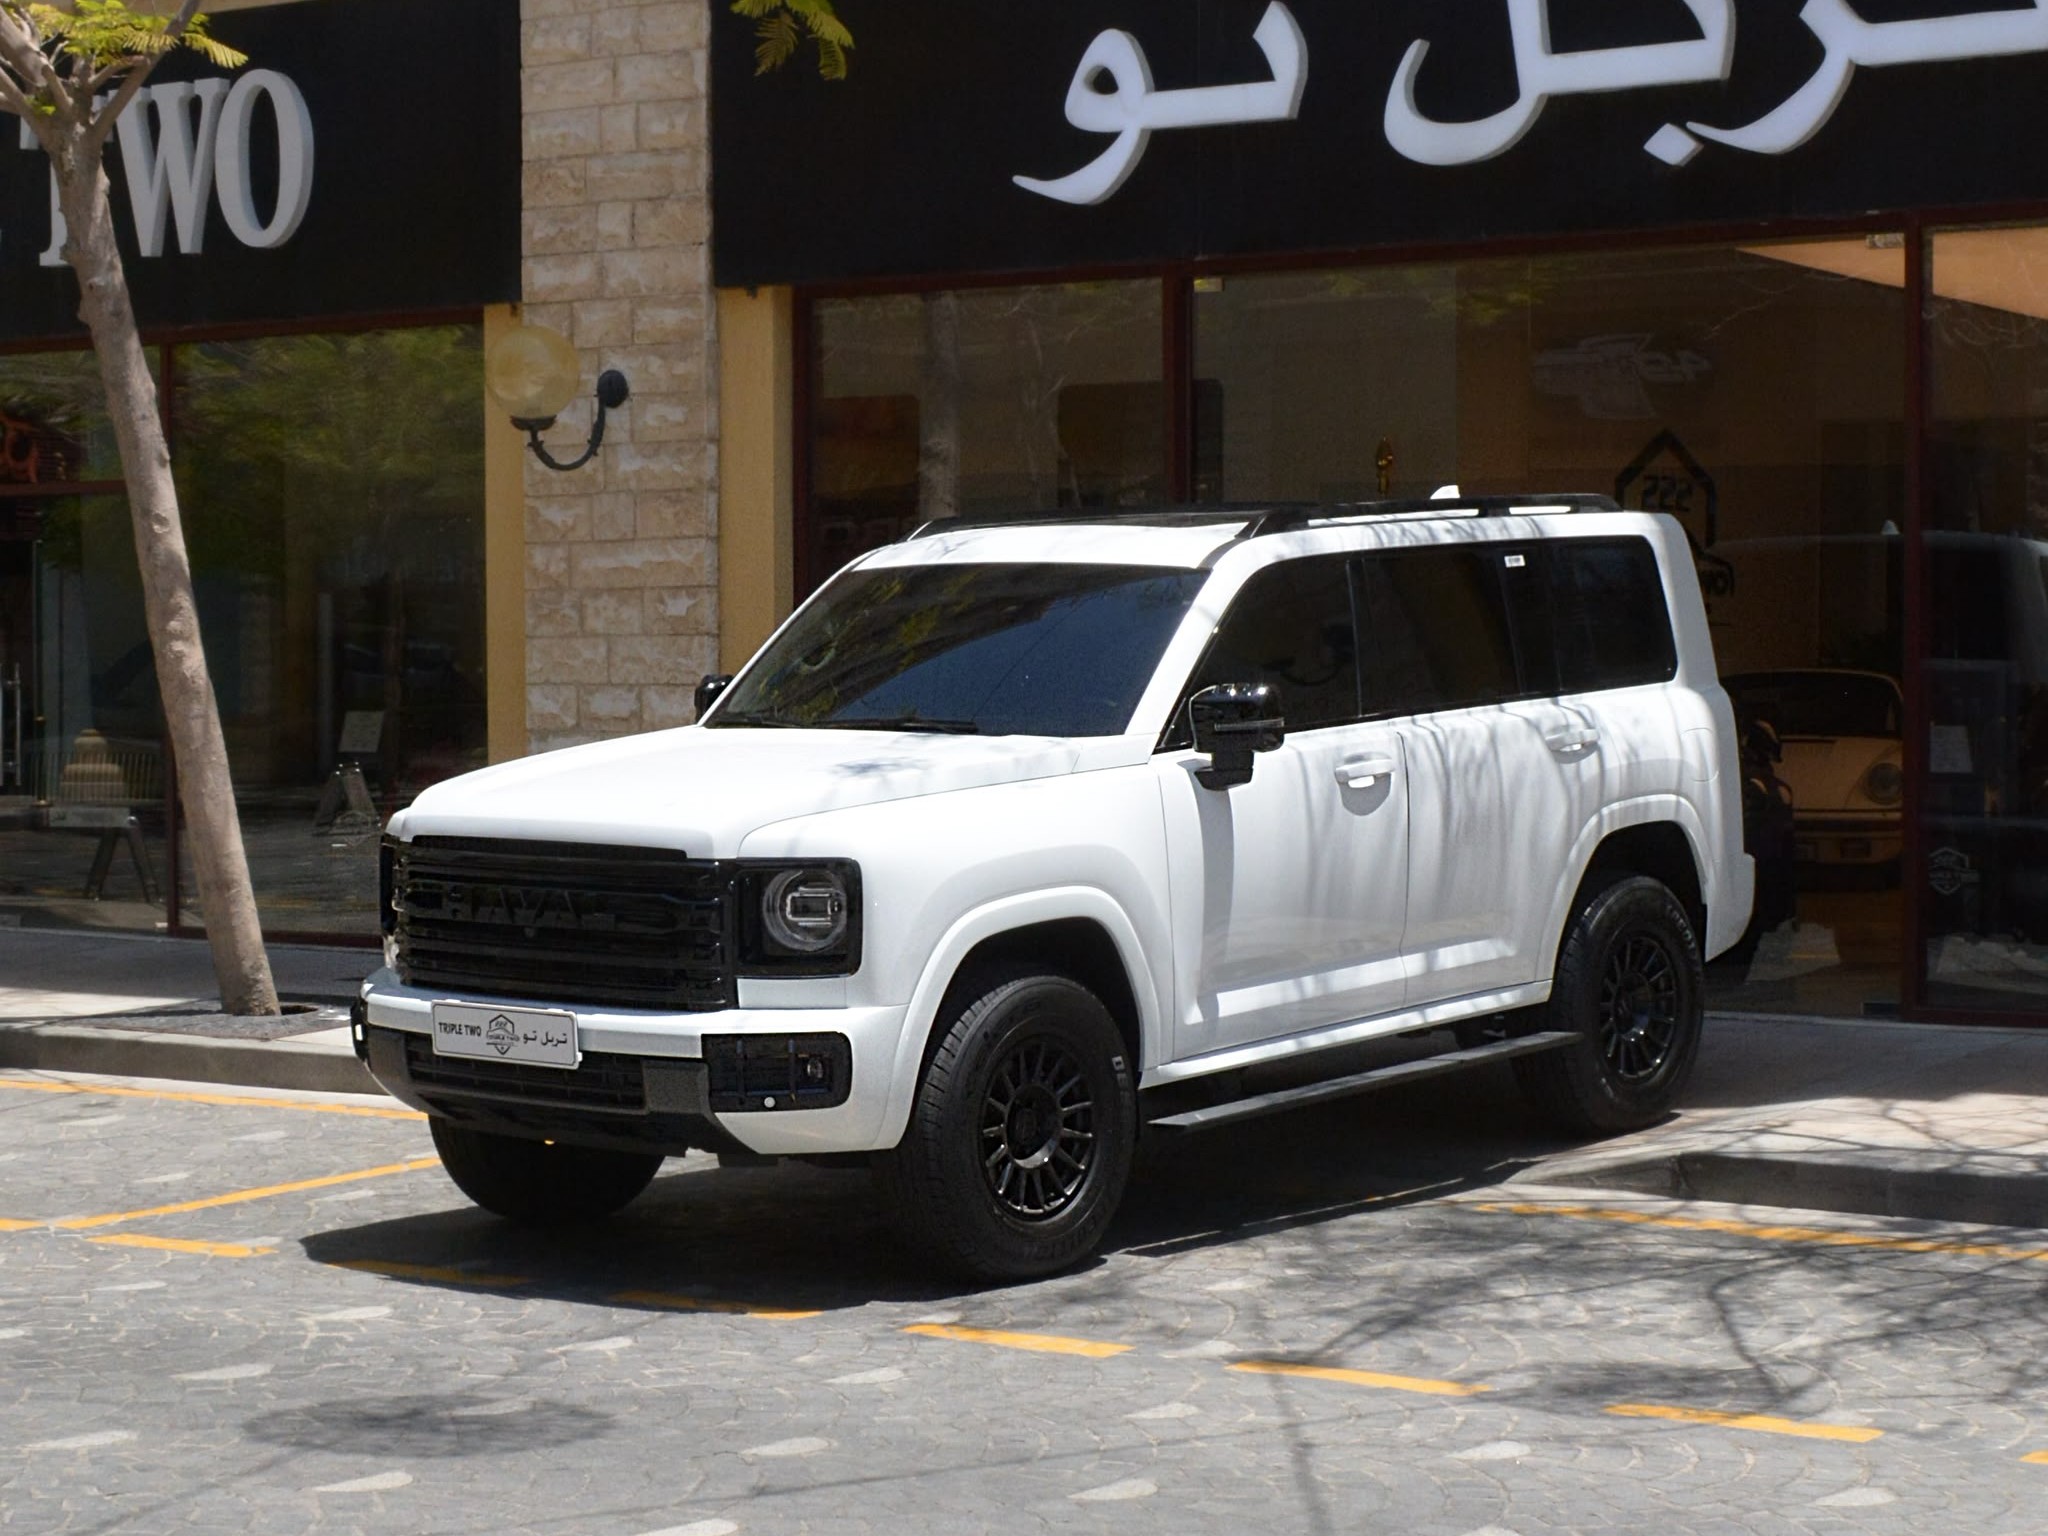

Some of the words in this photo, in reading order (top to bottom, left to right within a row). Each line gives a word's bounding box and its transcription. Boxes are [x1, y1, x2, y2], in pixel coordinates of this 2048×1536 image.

[445, 881, 616, 931] HAVAL
[438, 1022, 463, 1035] TRIPLE
[464, 1025, 482, 1037] TWO
[523, 1030, 538, 1044] تو
[540, 1031, 568, 1047] تربل
